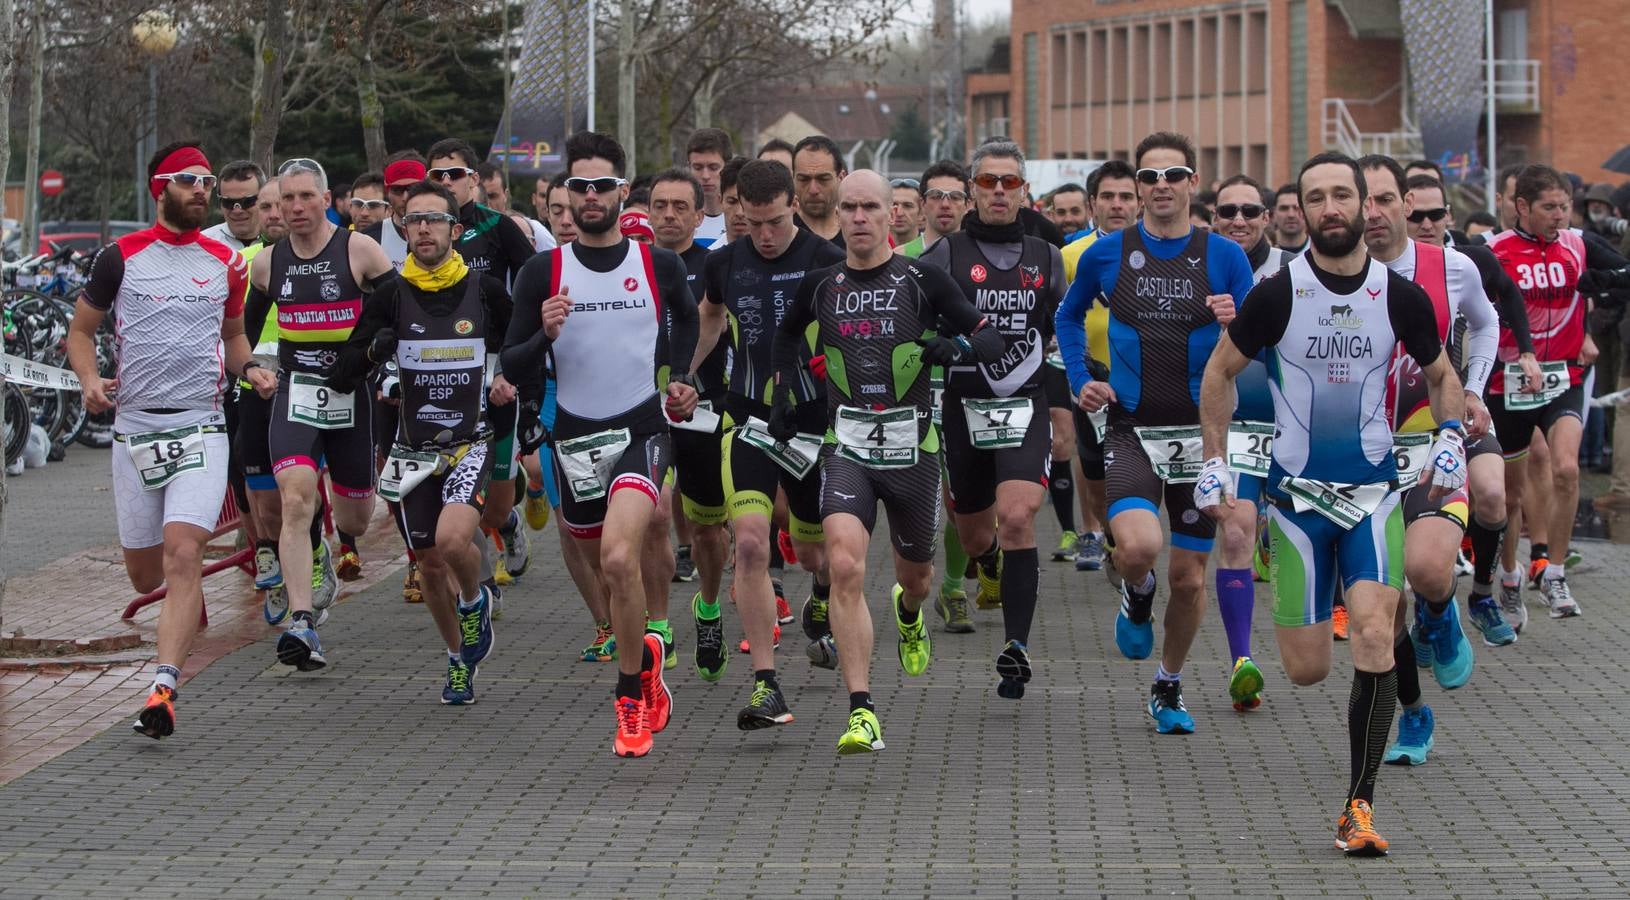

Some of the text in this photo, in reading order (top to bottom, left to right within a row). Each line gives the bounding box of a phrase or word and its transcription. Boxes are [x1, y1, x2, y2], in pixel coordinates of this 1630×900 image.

[285, 261, 331, 276] JIMENEZ
[1516, 262, 1566, 290] 360
[1136, 276, 1193, 299] CASTILLEJO
[836, 289, 898, 314] LOPEZ
[976, 289, 1036, 310] MORENO
[989, 327, 1038, 379] RNEDO
[1305, 331, 1373, 359] ZUÑIGA
[413, 372, 470, 386] APARICIO
[1517, 373, 1560, 391] 19
[316, 388, 329, 408] 9
[429, 387, 454, 400] ESP
[416, 411, 464, 420] MAGLIA
[984, 410, 1013, 427] 17
[866, 422, 887, 446] 4
[149, 441, 185, 464] 18
[1167, 440, 1185, 461] 2
[1247, 434, 1274, 458] 20
